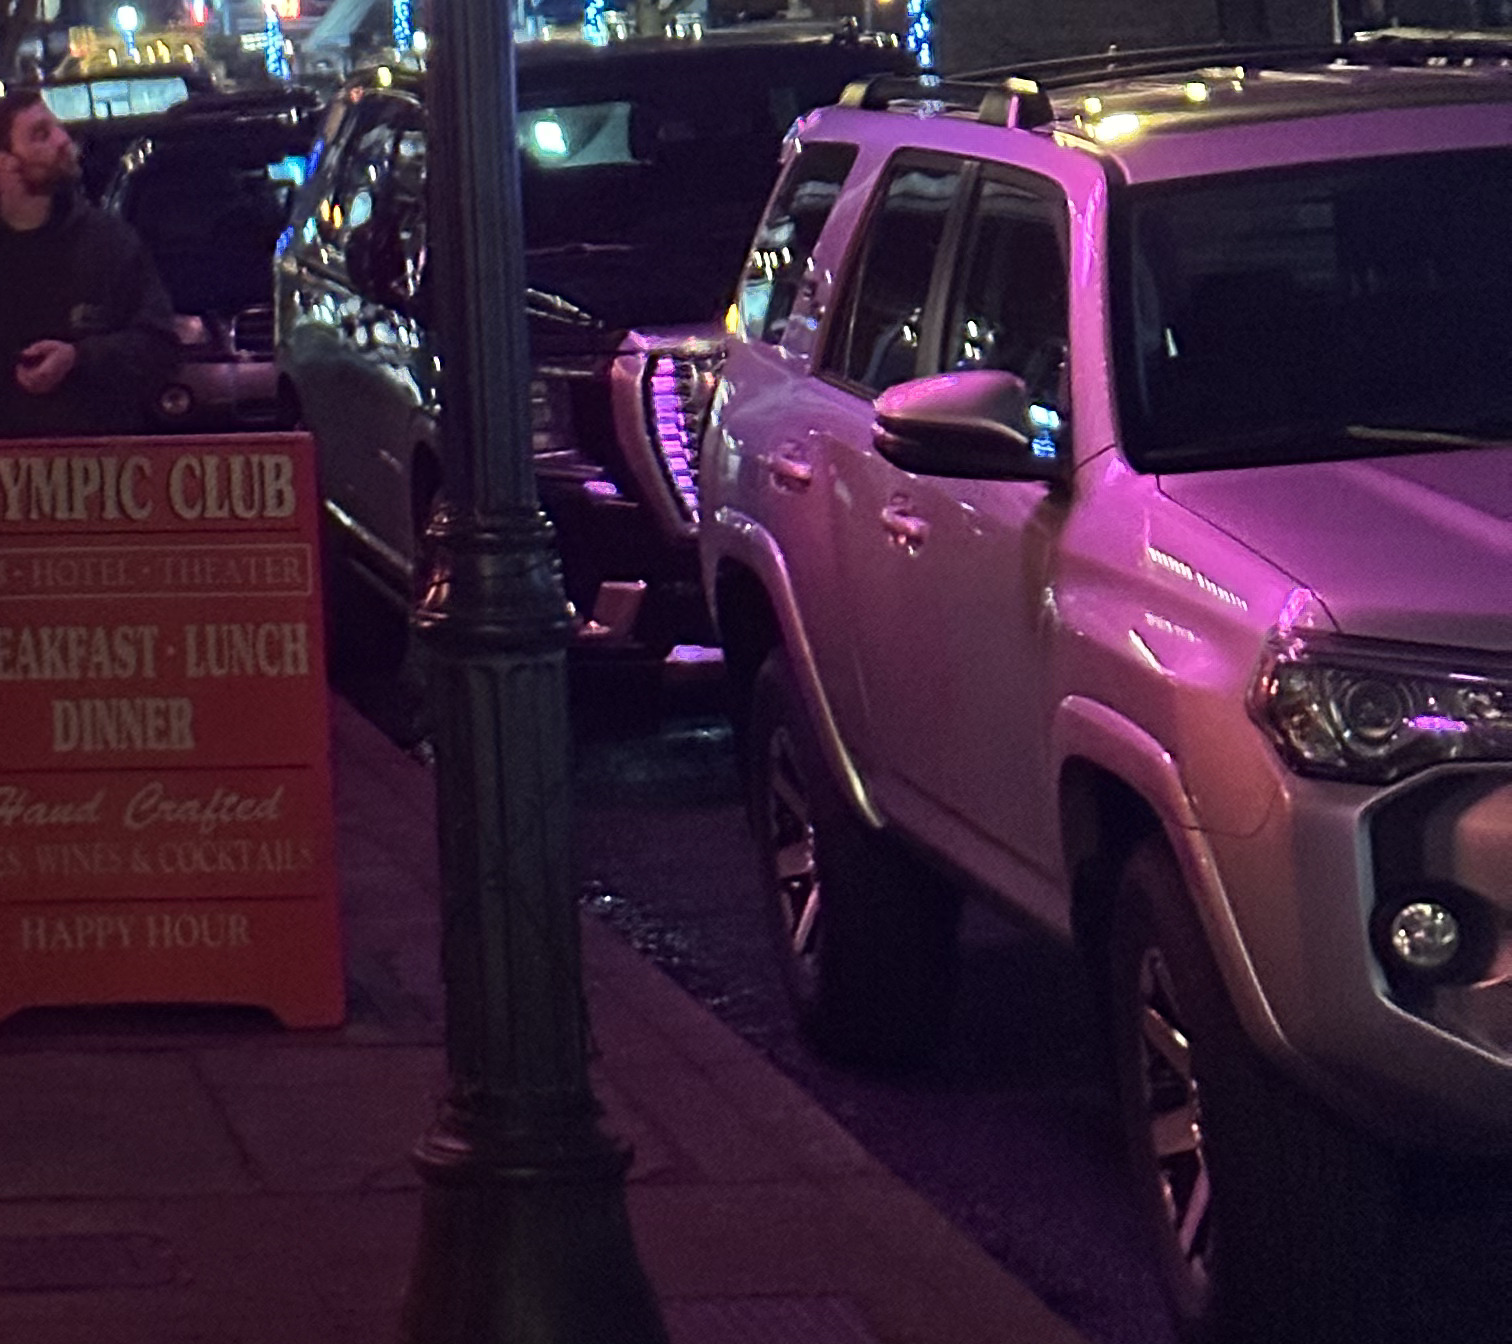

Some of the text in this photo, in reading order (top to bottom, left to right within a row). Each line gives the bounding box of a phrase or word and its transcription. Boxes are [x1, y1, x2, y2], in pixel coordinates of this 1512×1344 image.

[168, 453, 297, 520] CLUB
[31, 558, 136, 587] HOTEL
[162, 556, 303, 586] THEATER
[184, 621, 310, 678] LUNCH
[50, 696, 196, 753] DINNER
[123, 780, 286, 834] Crafted
[19, 913, 253, 952] HAPPY HOUR
